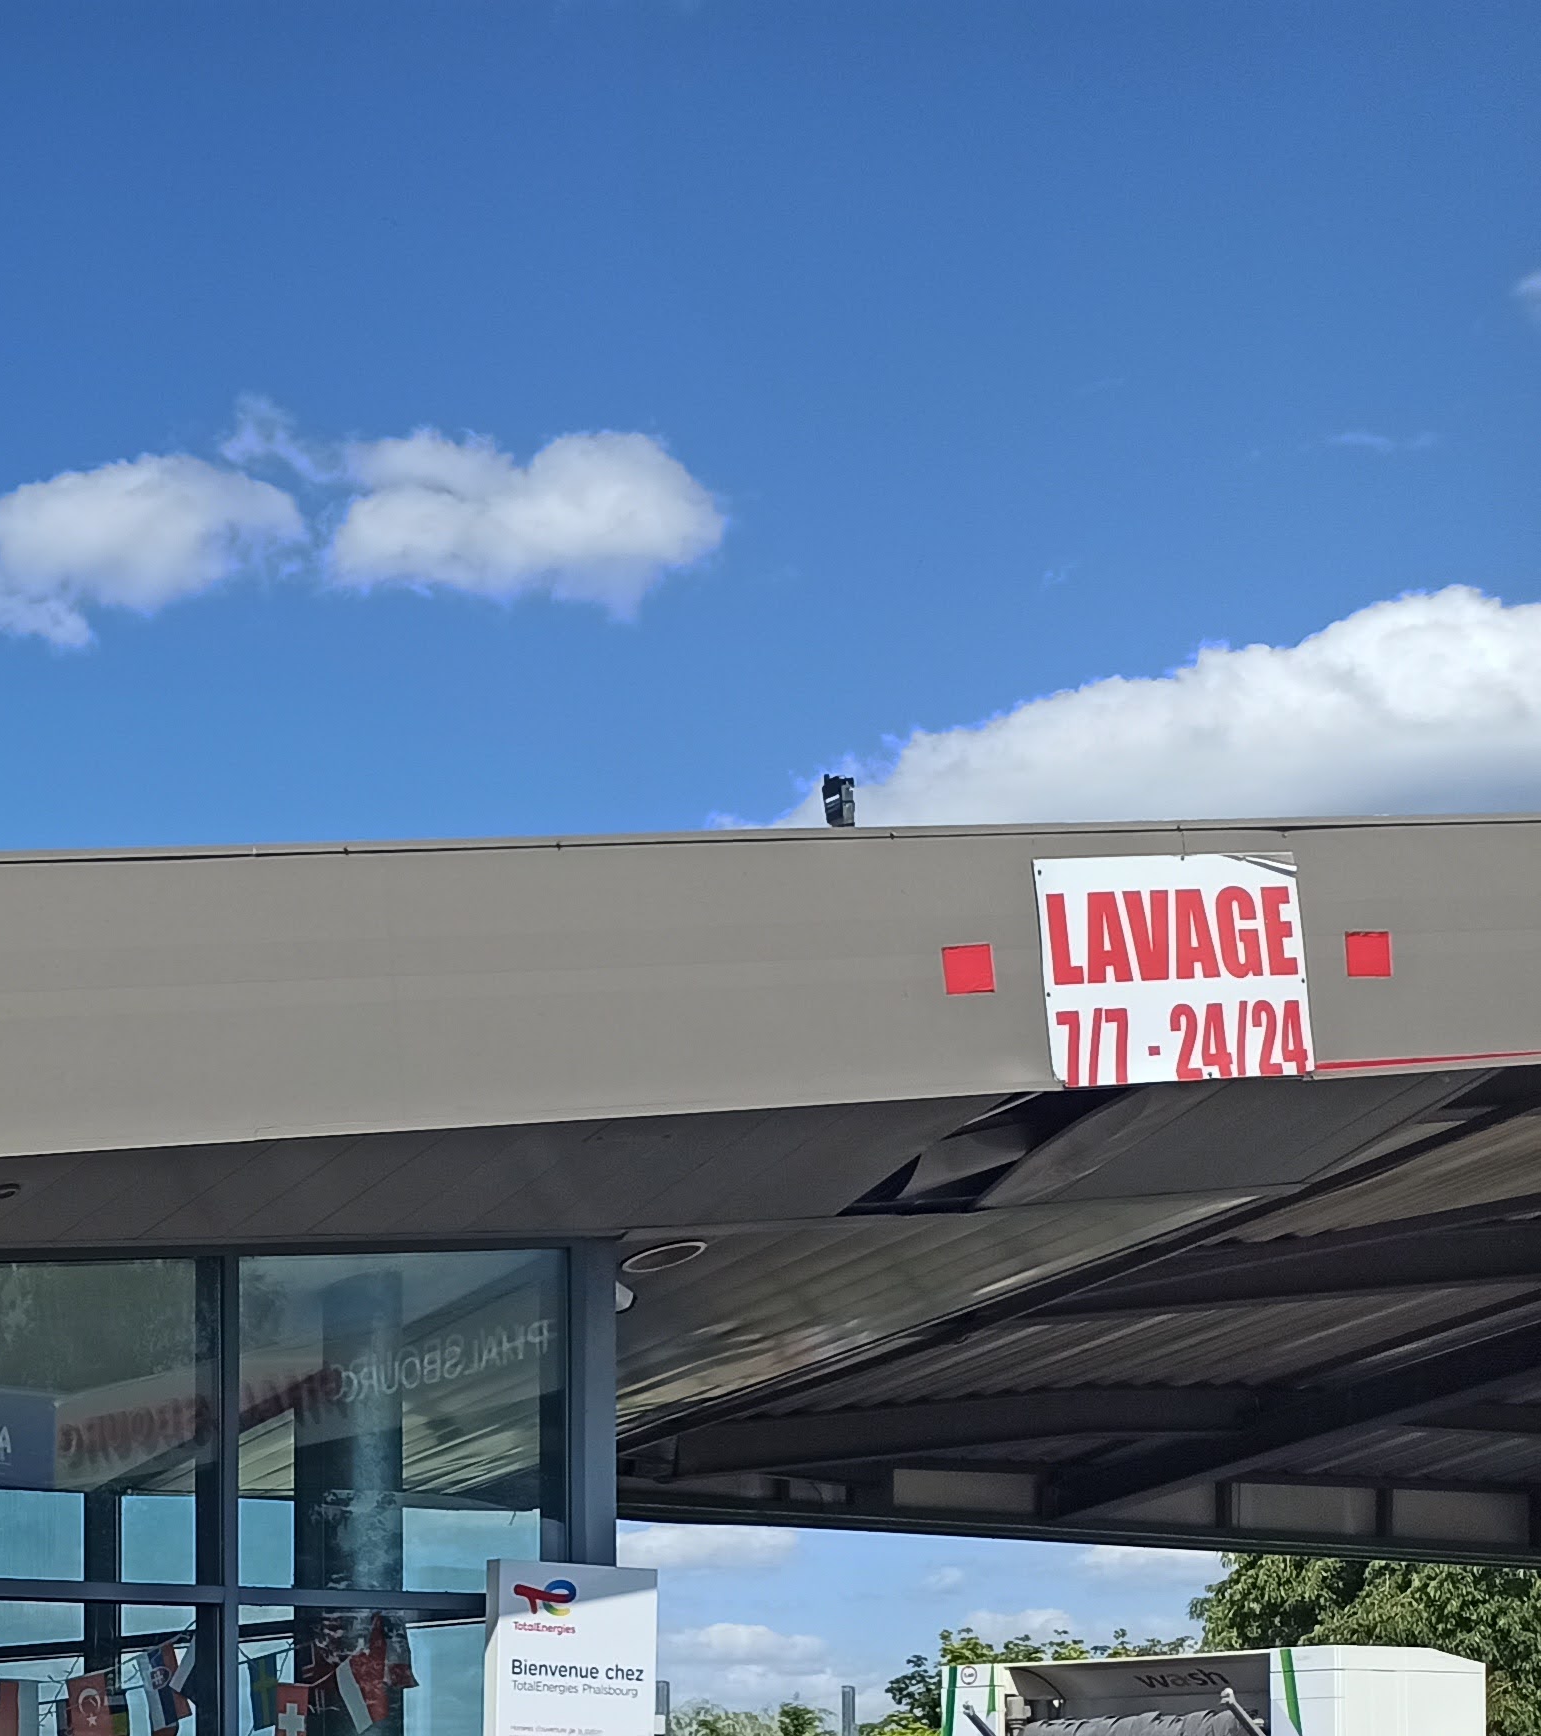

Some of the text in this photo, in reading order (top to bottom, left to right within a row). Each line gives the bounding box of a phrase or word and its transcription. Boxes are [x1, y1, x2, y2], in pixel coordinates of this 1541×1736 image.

[1045, 886, 1299, 986] LAVAGE
[1056, 1008, 1129, 1087] 7/7
[1169, 1000, 1308, 1081] 24/24
[513, 1621, 576, 1636] TotalEnergies
[511, 1658, 645, 1682] Bienvenue chez
[1134, 1668, 1230, 1690] wash
[511, 1680, 638, 1699] TotalEnergies Phalsbourg
